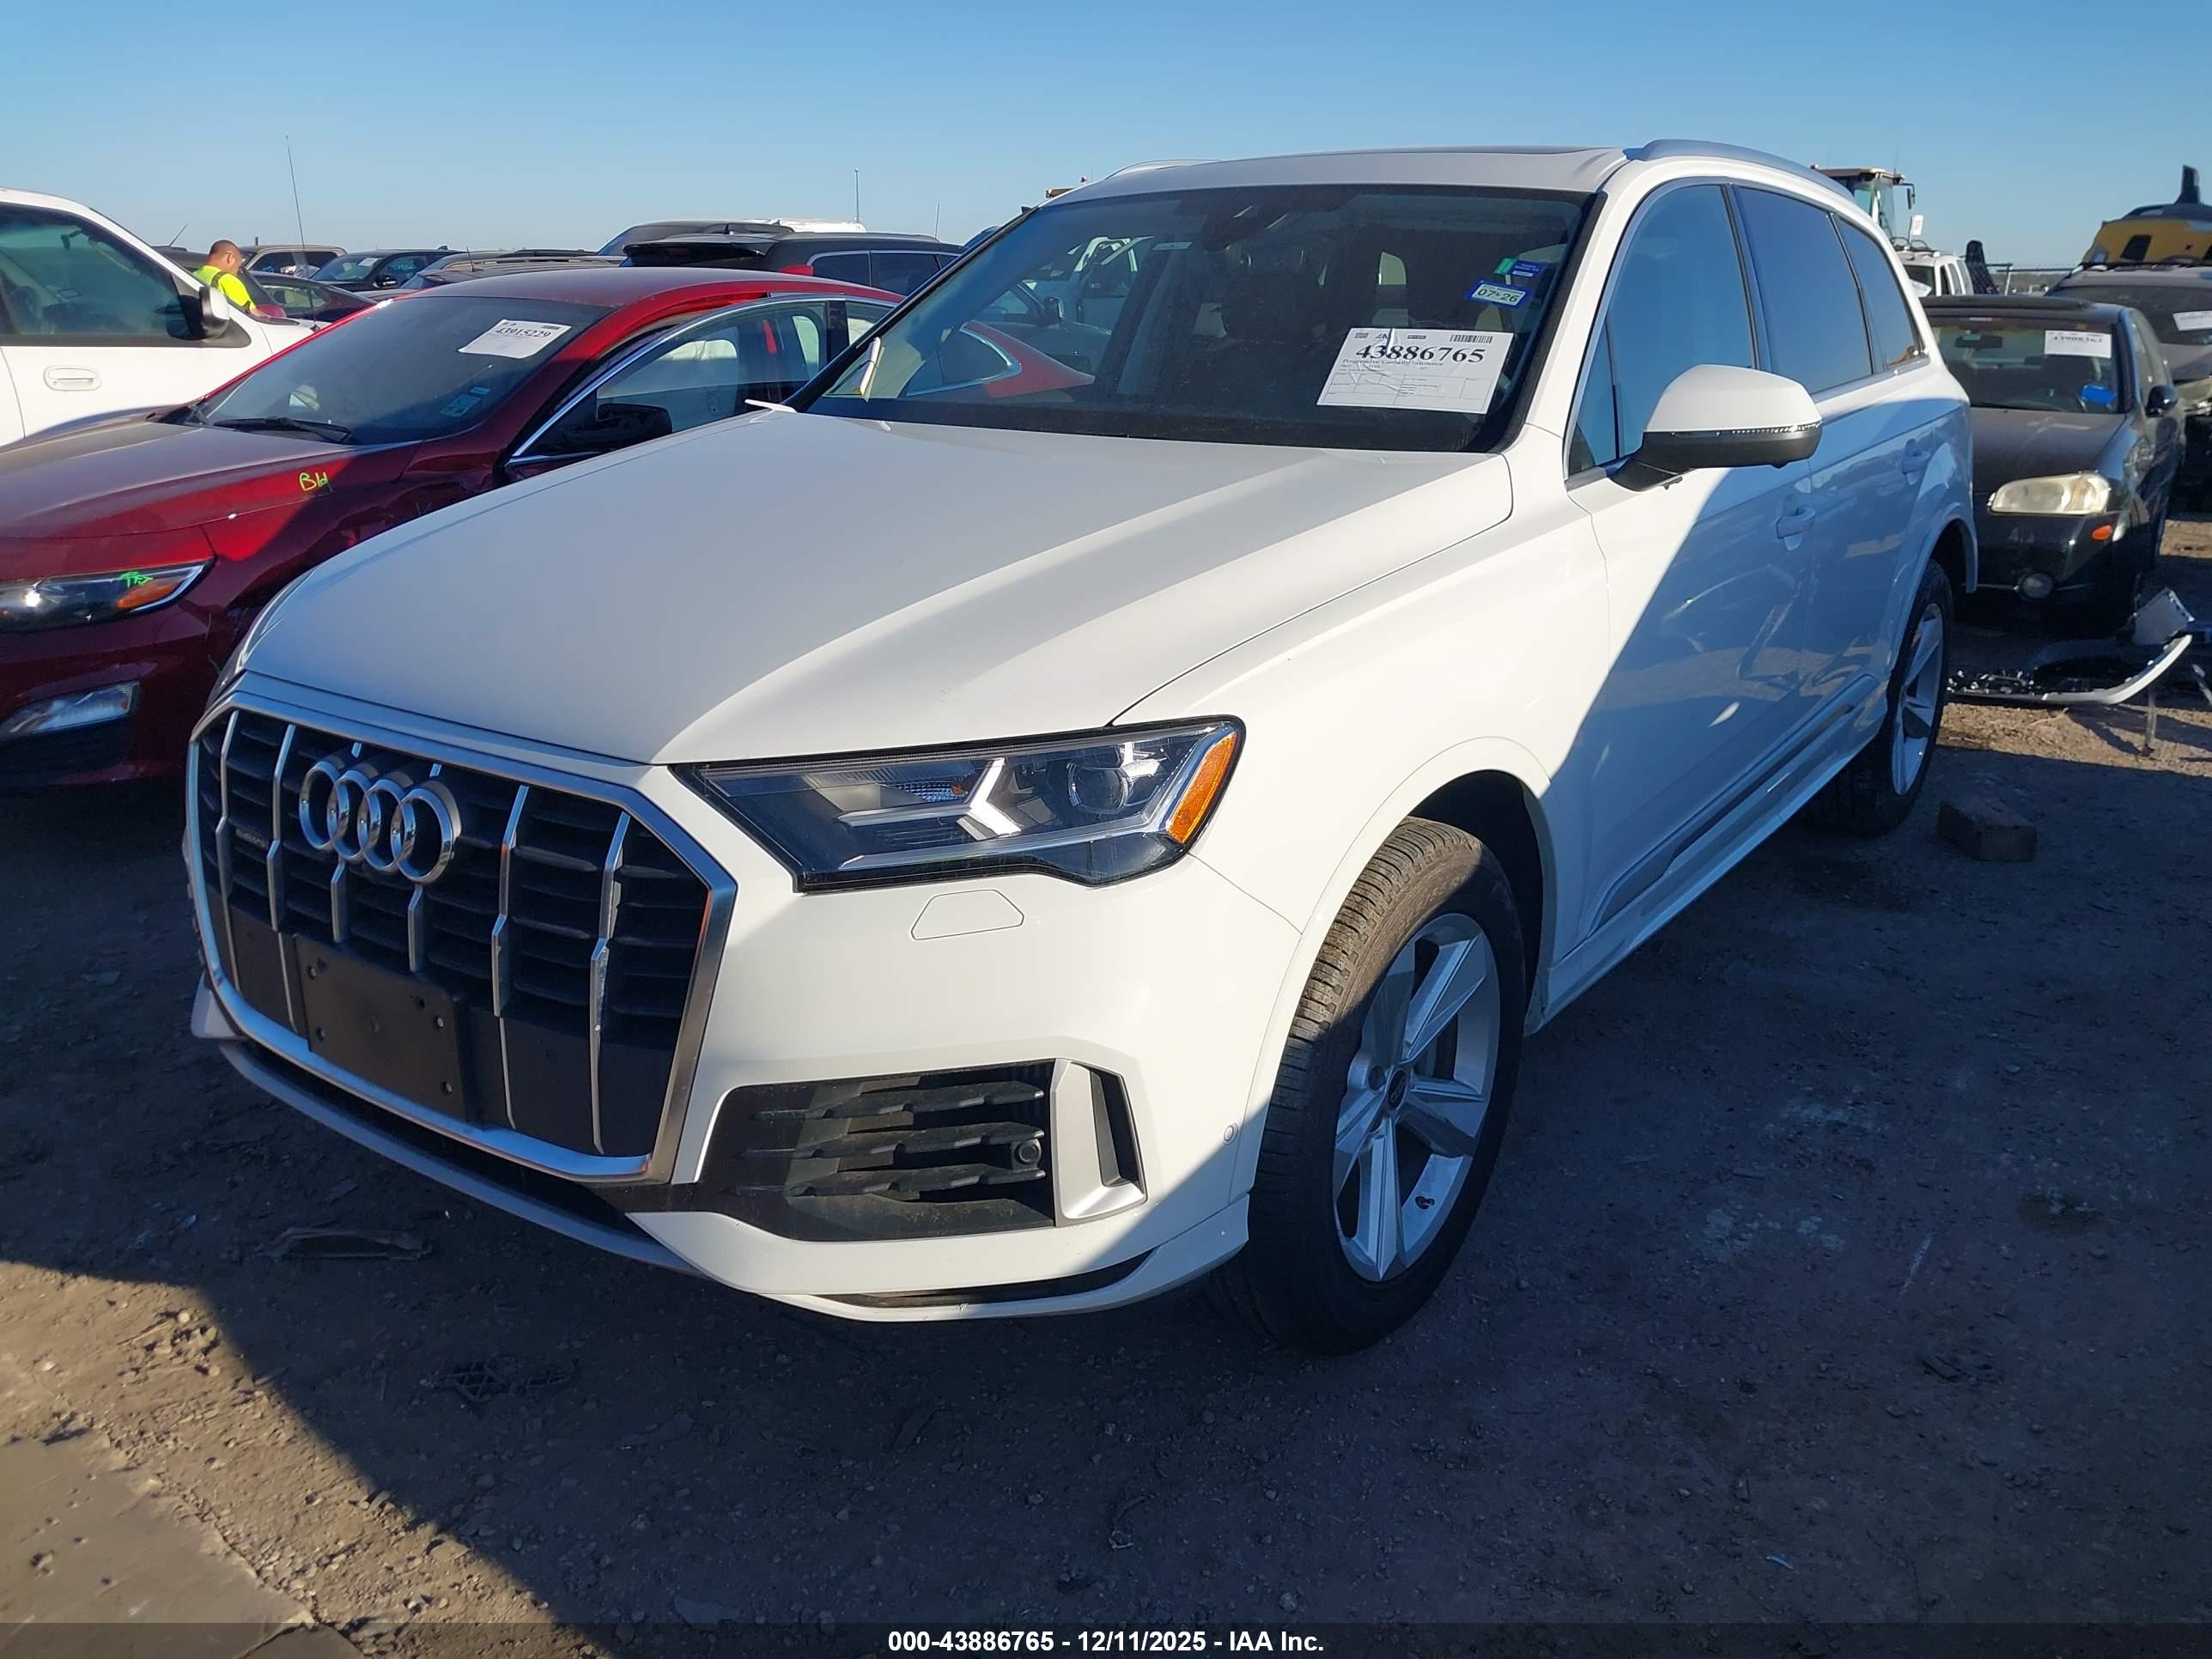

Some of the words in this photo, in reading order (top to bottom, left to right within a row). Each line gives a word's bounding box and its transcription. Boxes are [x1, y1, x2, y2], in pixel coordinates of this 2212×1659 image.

[1502, 293, 1520, 302] 26
[495, 327, 552, 338] 43915229
[1355, 344, 1486, 363] 43886765
